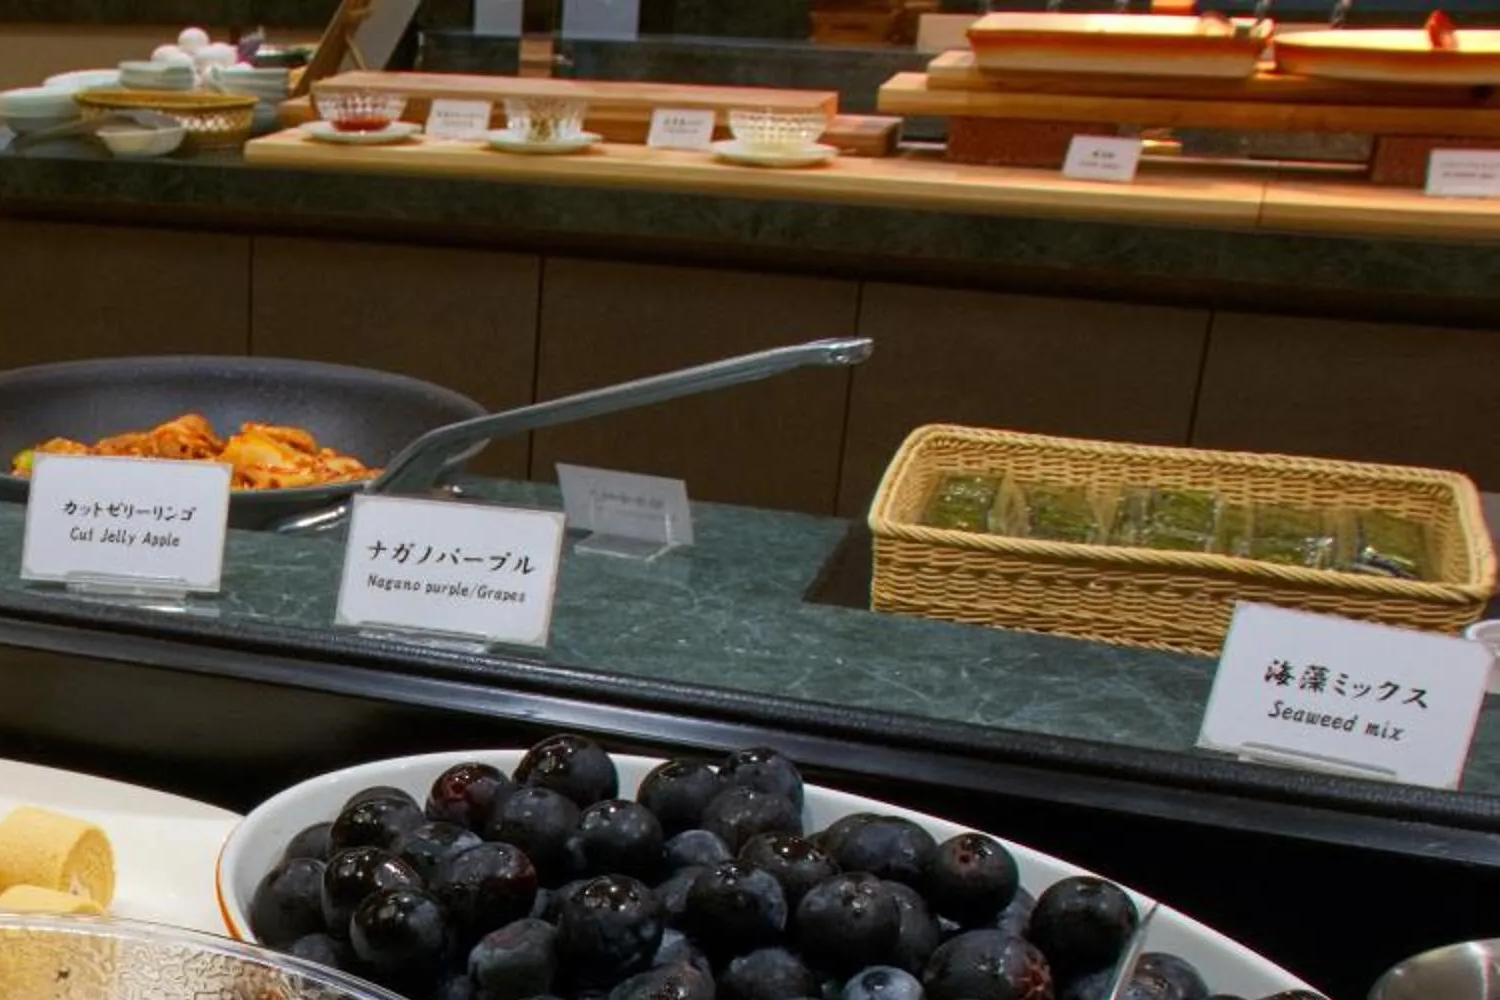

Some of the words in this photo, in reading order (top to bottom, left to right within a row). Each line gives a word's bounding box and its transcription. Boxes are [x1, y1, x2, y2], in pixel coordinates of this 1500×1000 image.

[63, 499, 197, 521] カットゼリーリンゴ
[69, 526, 93, 542] Cut
[100, 527, 135, 545] Jelly
[141, 531, 180, 547] Apple
[367, 540, 535, 575] ナガノパープル
[366, 572, 421, 592] Nagano
[425, 580, 526, 604] purple/Grapes
[1263, 659, 1429, 709] 海藻ミックス
[1267, 700, 1358, 732] Seaweed
[1364, 720, 1405, 741] mix
